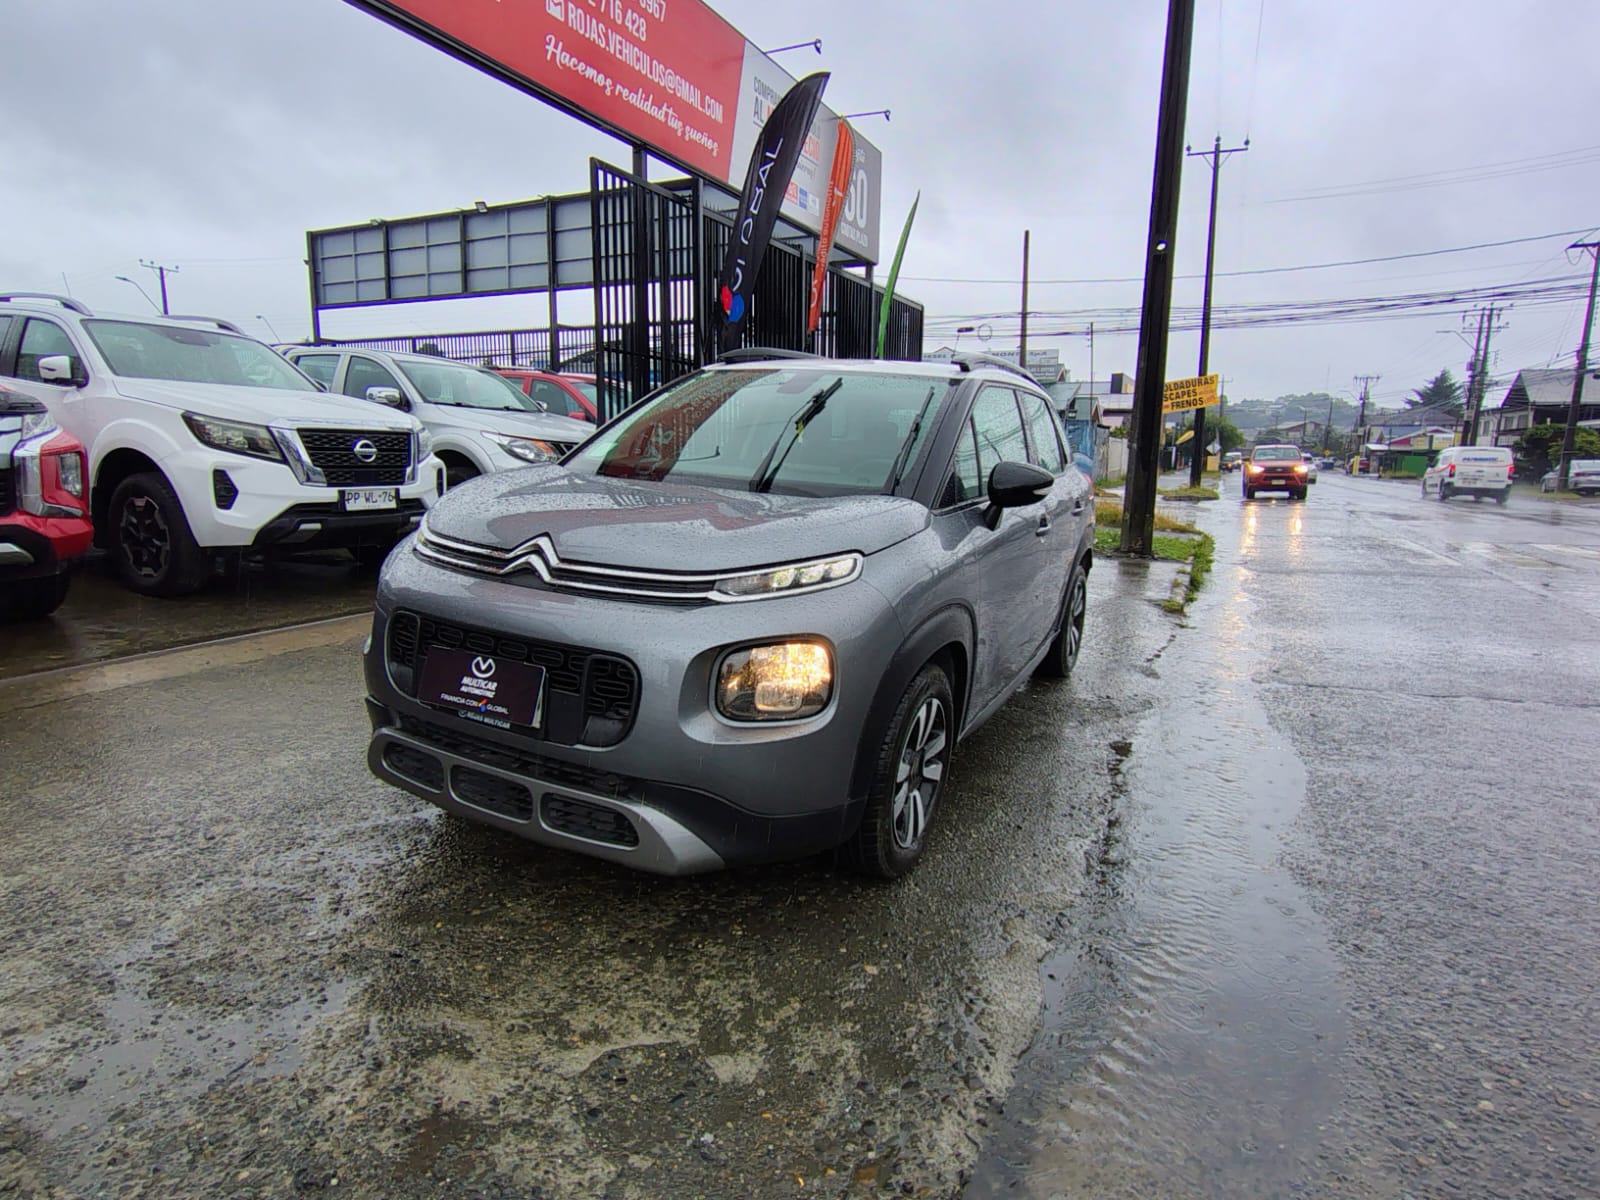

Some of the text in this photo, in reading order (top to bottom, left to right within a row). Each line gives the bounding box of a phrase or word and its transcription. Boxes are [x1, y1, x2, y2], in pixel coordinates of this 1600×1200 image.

[624, 8, 647, 42] 428
[567, 1, 723, 124] ROJAS.VEHICULOS@GMAIL.COM
[545, 34, 719, 158] Hacemos realidad tus sueños
[1171, 397, 1204, 410] FRENOS
[486, 703, 509, 715] GLOBAL
